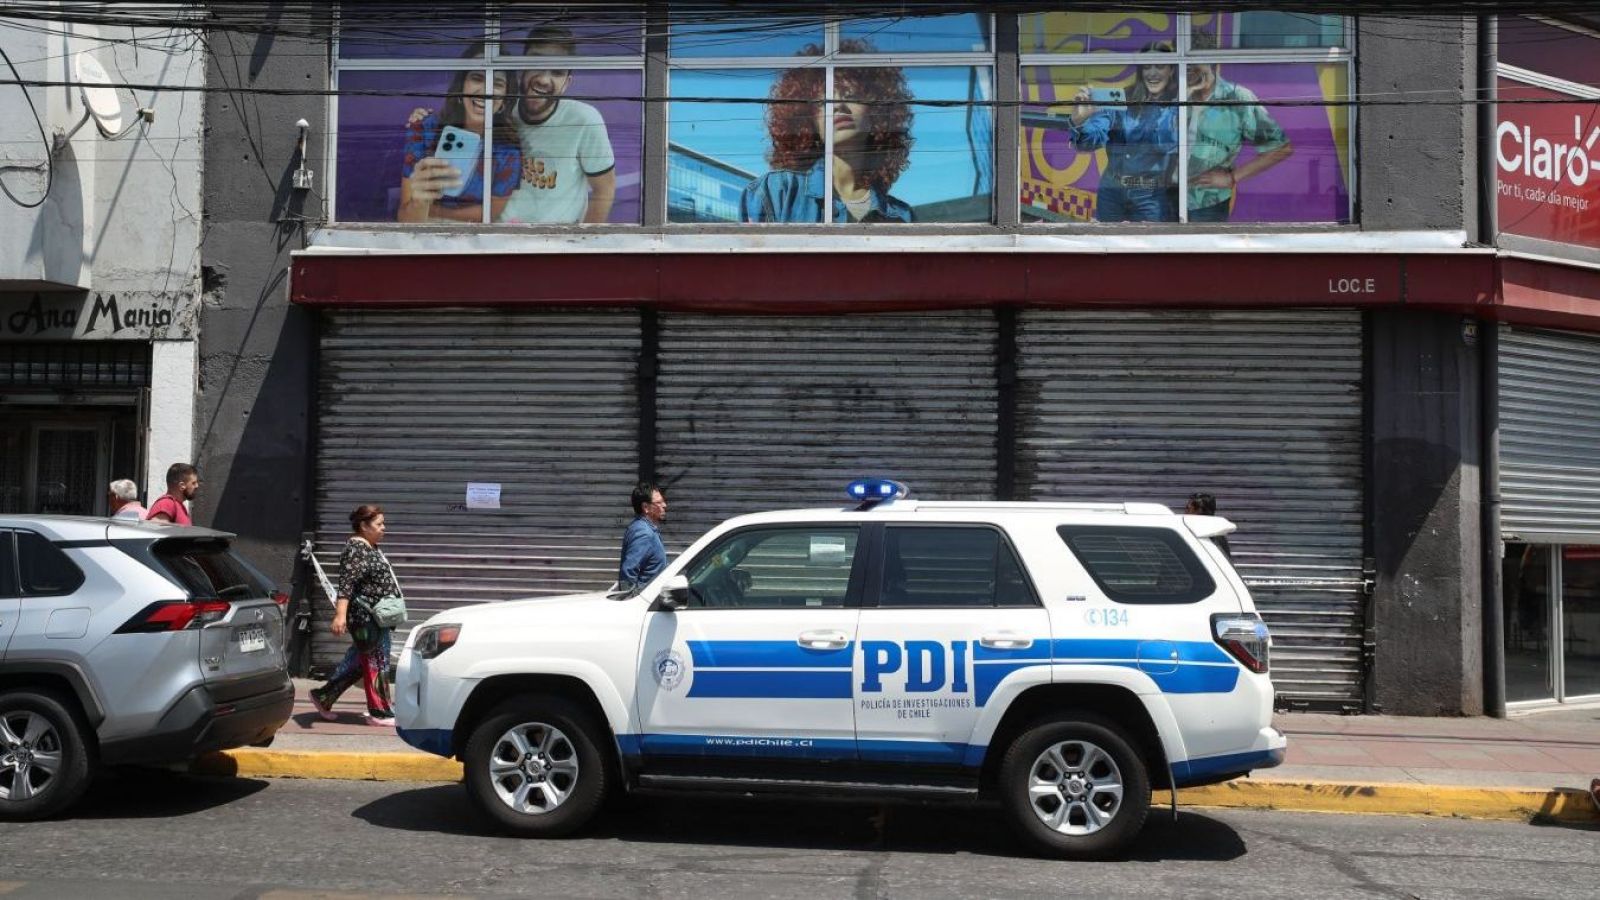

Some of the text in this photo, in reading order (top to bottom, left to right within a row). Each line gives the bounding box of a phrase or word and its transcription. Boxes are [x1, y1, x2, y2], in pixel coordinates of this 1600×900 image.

[1497, 120, 1589, 186] Claro
[1497, 180, 1512, 196] Por
[1525, 188, 1546, 202] cada
[1563, 195, 1589, 213] mejor
[1329, 278, 1376, 293] LOC.E
[8, 292, 77, 334] Ana
[1102, 608, 1128, 626] 134
[861, 640, 968, 692] PDI
[893, 699, 901, 708] DE
[903, 699, 971, 708] INVESTIGACIONES
[897, 709, 930, 718] DE CHILE
